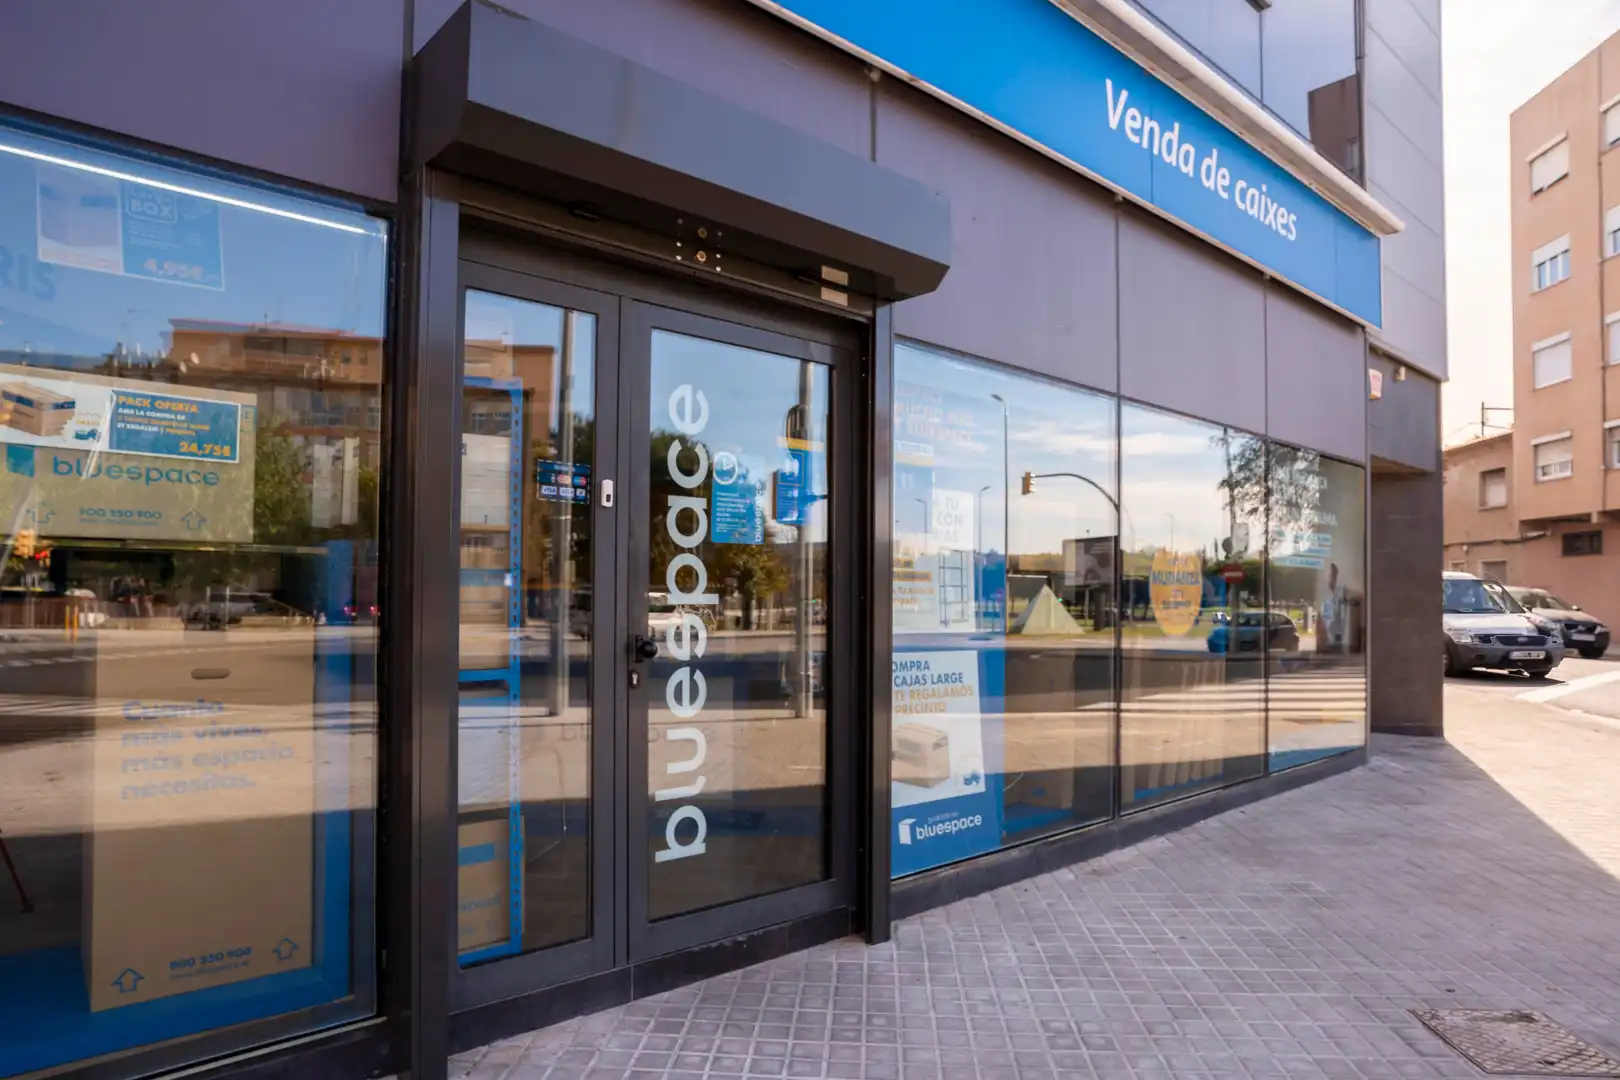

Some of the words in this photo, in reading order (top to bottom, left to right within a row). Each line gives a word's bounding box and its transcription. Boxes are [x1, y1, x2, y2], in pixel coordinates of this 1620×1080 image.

[1105, 78, 1195, 177] Venda
[1200, 148, 1230, 200] de
[1235, 179, 1297, 241] caixes
[130, 199, 173, 219] BOX
[118, 395, 151, 408] PACK
[154, 399, 199, 413] OFERTA
[52, 456, 220, 487] bluespace
[655, 384, 719, 863] bluespace
[893, 673, 928, 687] CAJAS
[931, 672, 964, 685] LARGE
[909, 685, 974, 701] REGALAMOS
[915, 813, 982, 841] bluespace
